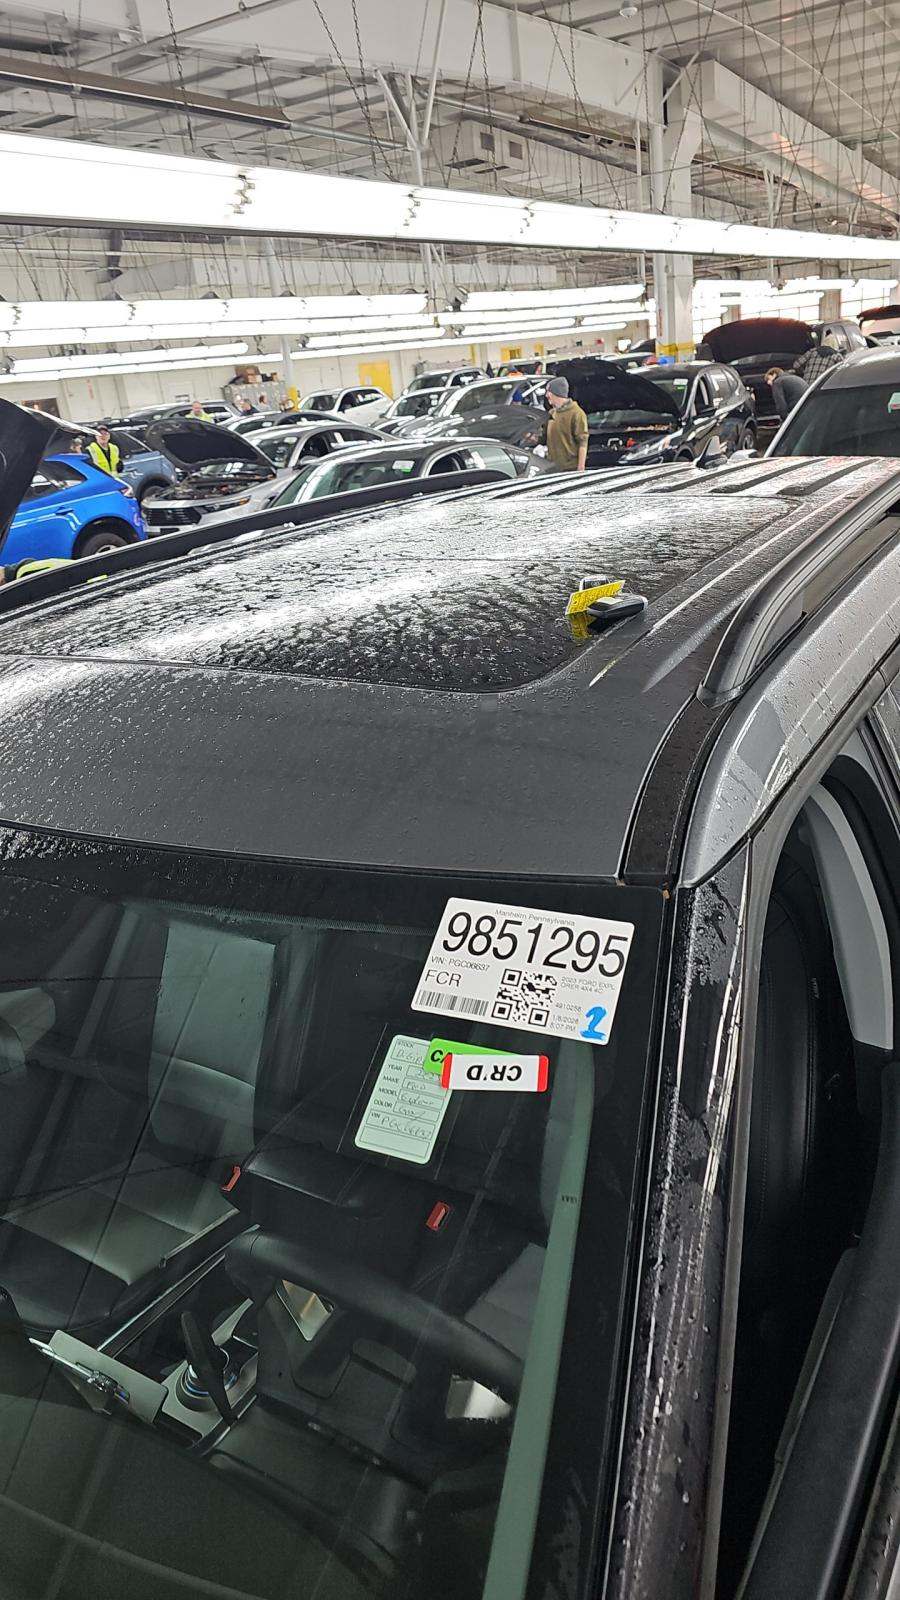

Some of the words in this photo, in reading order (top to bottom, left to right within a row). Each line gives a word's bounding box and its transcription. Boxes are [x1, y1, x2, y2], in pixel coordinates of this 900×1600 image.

[528, 914, 575, 927] Pennsylvania
[442, 911, 629, 978] 9851295
[431, 955, 447, 965] VIN:
[424, 969, 462, 988] FCR
[578, 978, 598, 988] FORD
[388, 1064, 403, 1072] YEAR
[378, 1087, 398, 1097] MODEL
[373, 1098, 393, 1108] COLOR
